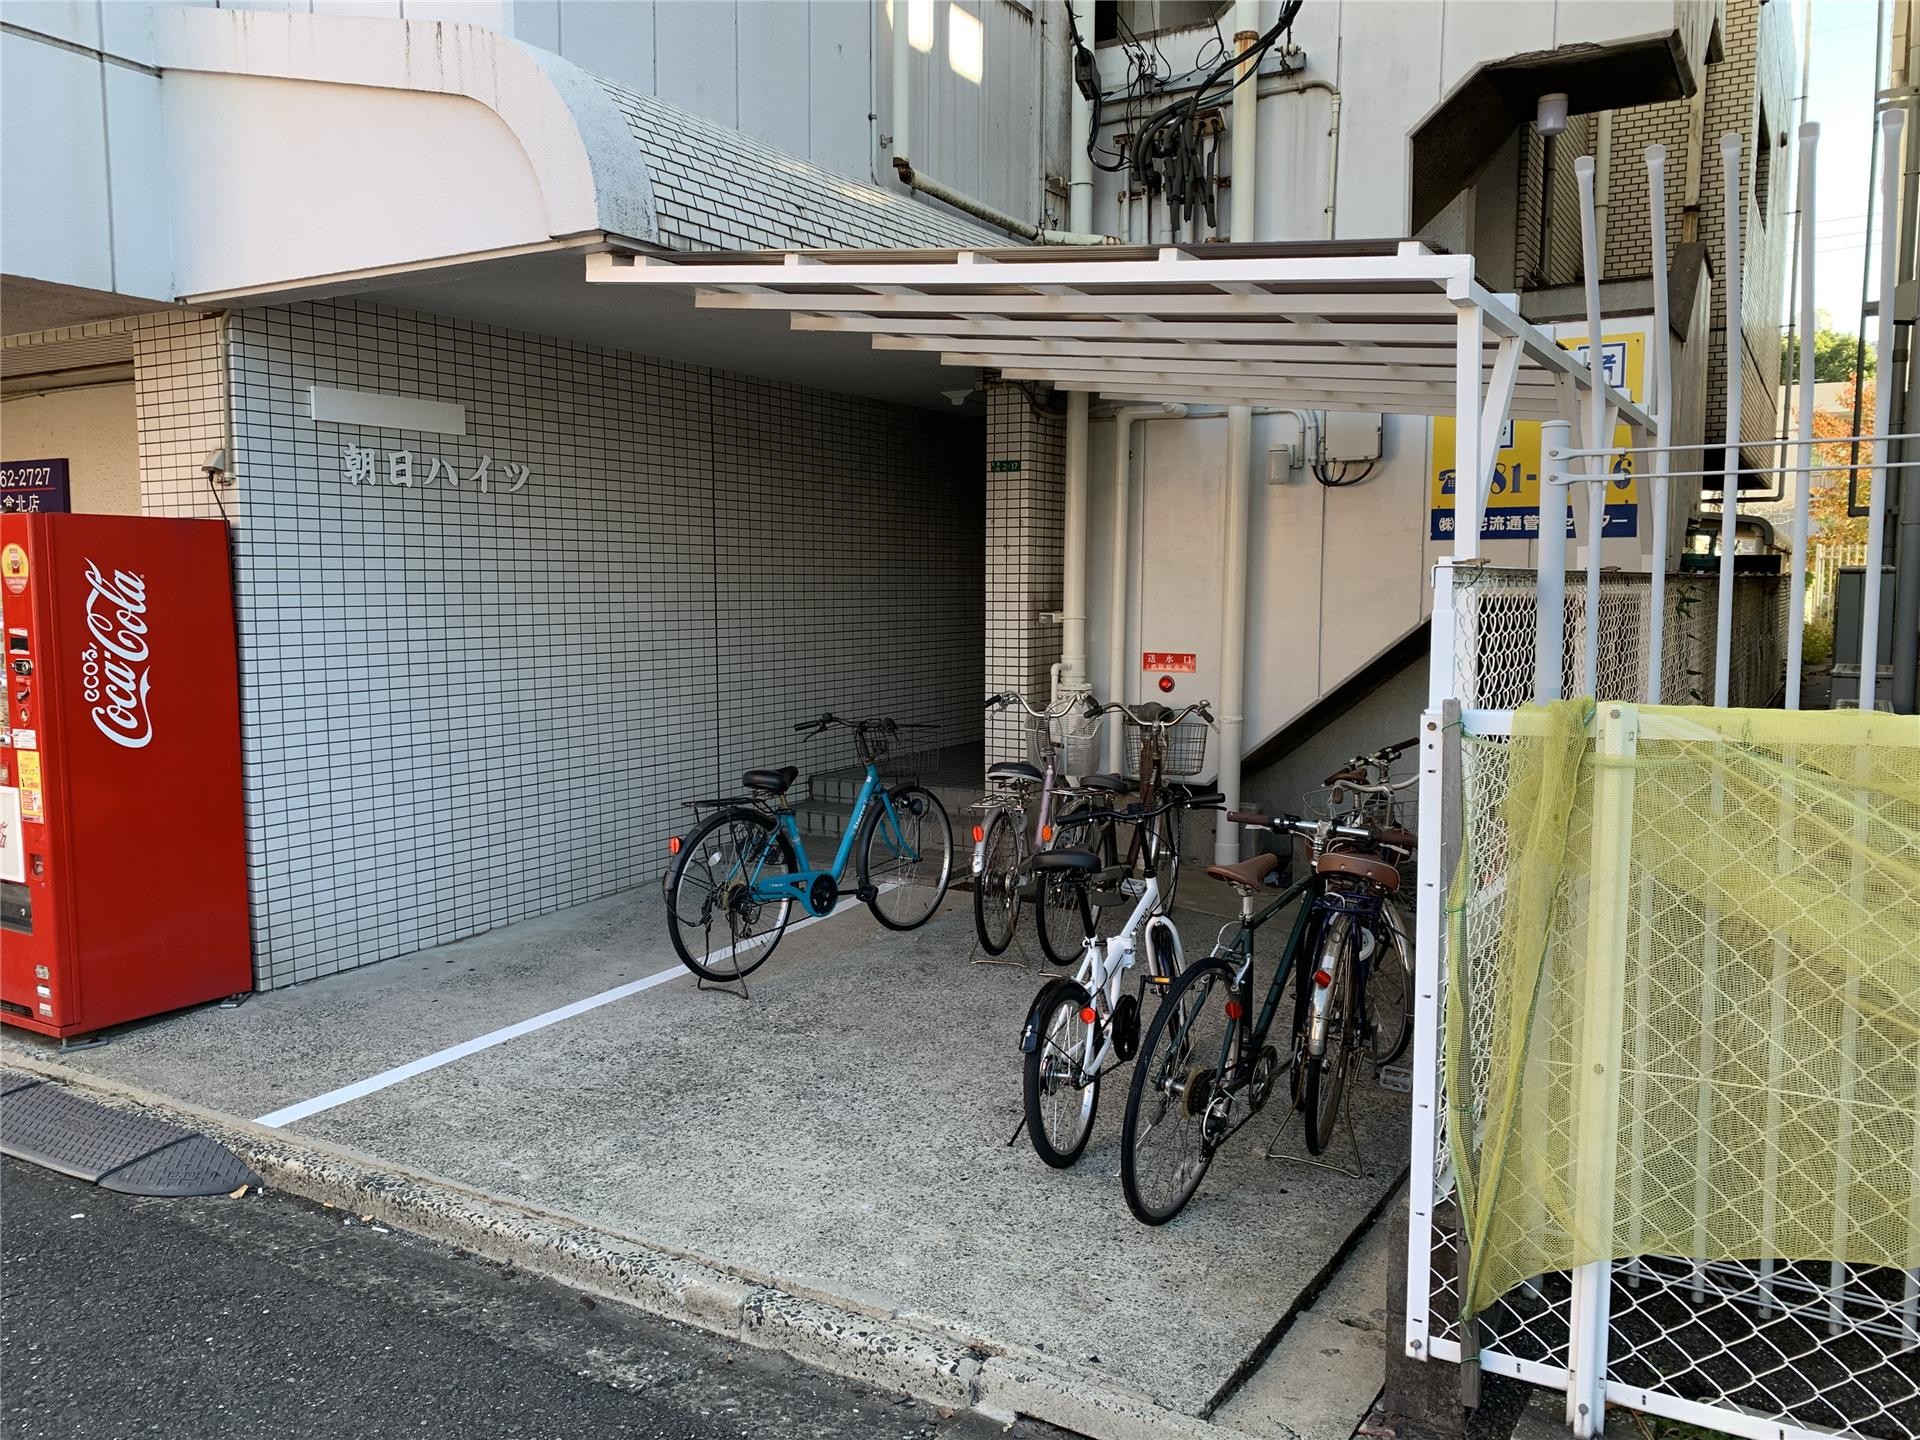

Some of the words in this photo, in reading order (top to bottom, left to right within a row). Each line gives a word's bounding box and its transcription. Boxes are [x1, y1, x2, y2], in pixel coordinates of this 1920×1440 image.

[344, 442, 530, 494] 朝日ハイツ
[84, 557, 153, 749] Coca-Cola
[1148, 654, 1192, 664] 送水口
